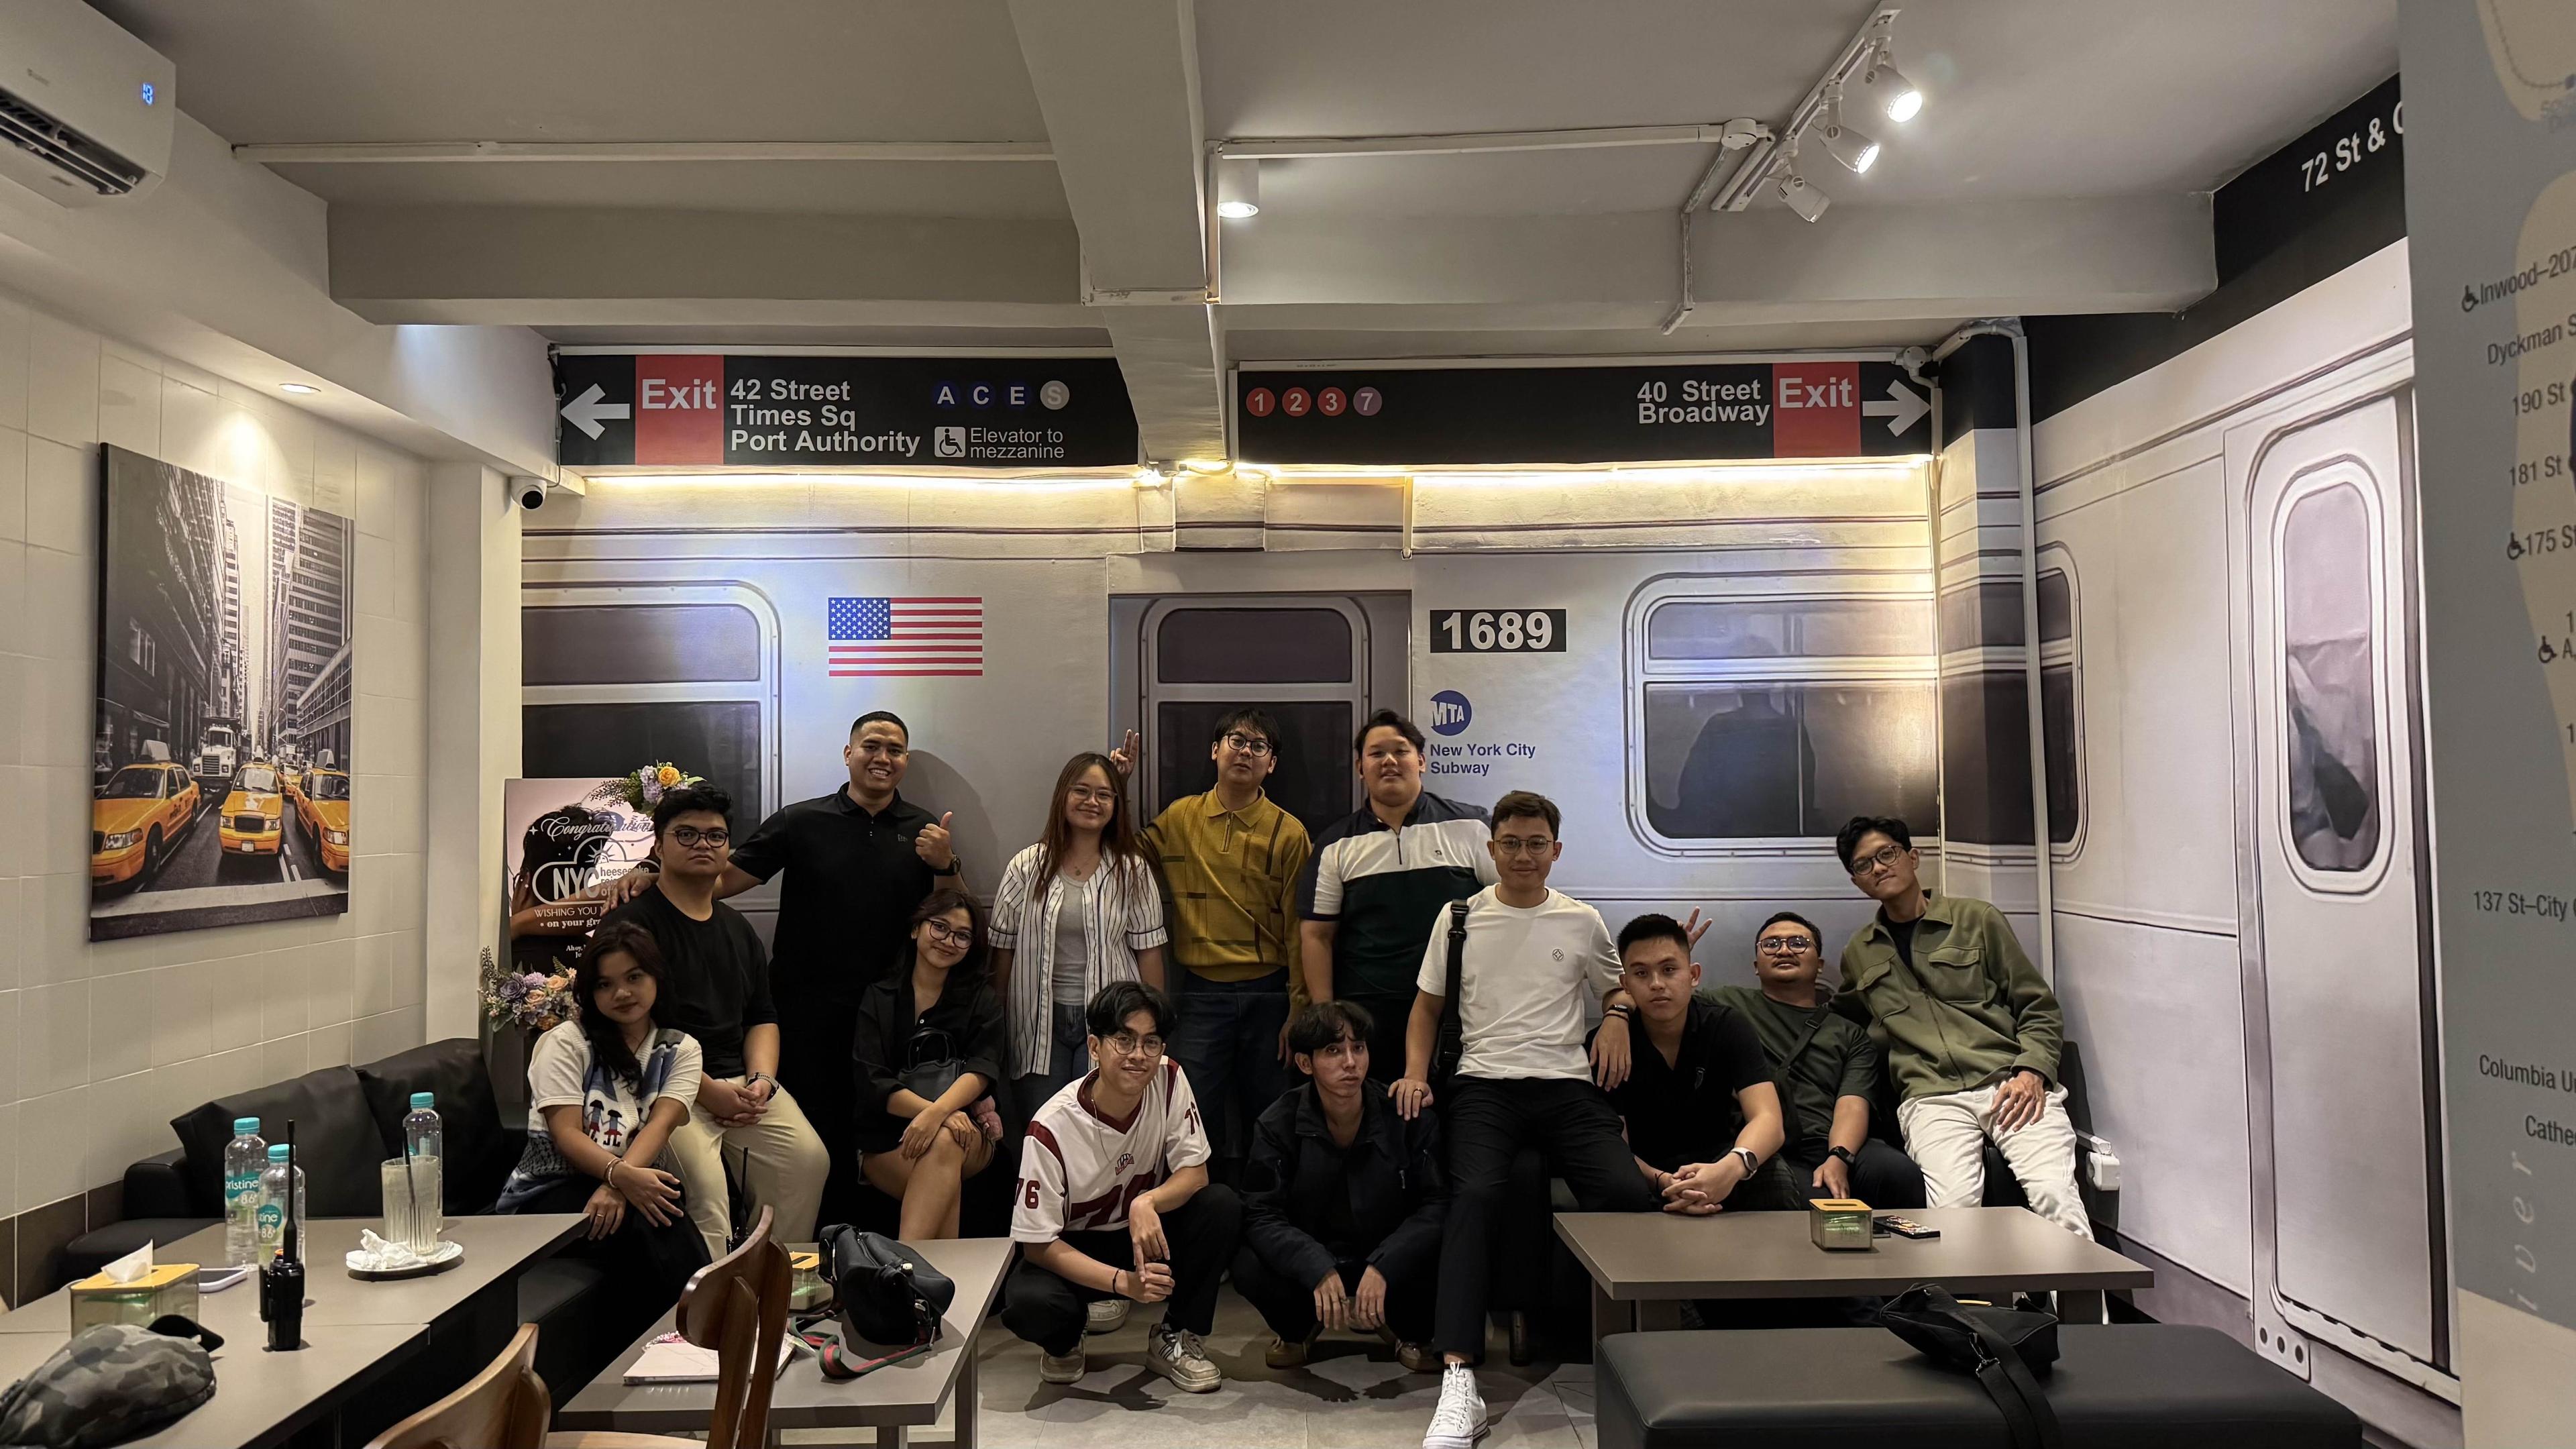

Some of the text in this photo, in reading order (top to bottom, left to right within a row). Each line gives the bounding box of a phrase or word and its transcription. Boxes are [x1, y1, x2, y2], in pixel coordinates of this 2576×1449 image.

[2302, 152, 2328, 192] 72
[2336, 132, 2361, 172] St
[2367, 117, 2386, 153] &
[2487, 324, 2562, 366] Dyckman
[642, 379, 716, 409] Exit
[731, 379, 850, 401] 42 Street
[937, 386, 1061, 405] A C E S
[1254, 393, 1373, 412] 1 2 3 7
[1638, 379, 1761, 402] 40 Street
[1779, 377, 1853, 408] Exit
[2513, 382, 2565, 416] 190 St
[731, 405, 855, 431] Times Sq
[1638, 400, 1770, 427] Broadway
[731, 429, 920, 457] Port Authority
[971, 427, 1063, 443] Elevator to
[971, 443, 1065, 458] mezzanine
[2510, 455, 2563, 486] 181 St
[2525, 529, 2556, 555] 175
[1442, 611, 1552, 650] 1689
[1432, 700, 1464, 727] MTA
[1430, 743, 1536, 759] New York City
[1430, 761, 1490, 777] Subway
[553, 867, 600, 900] NYC
[535, 907, 575, 917] WISHING
[578, 906, 597, 915] YOU
[2474, 891, 2502, 912] 137
[562, 920, 584, 929] your
[2479, 1055, 2556, 1089] Columbia
[2526, 1115, 2576, 1146] Cathe
